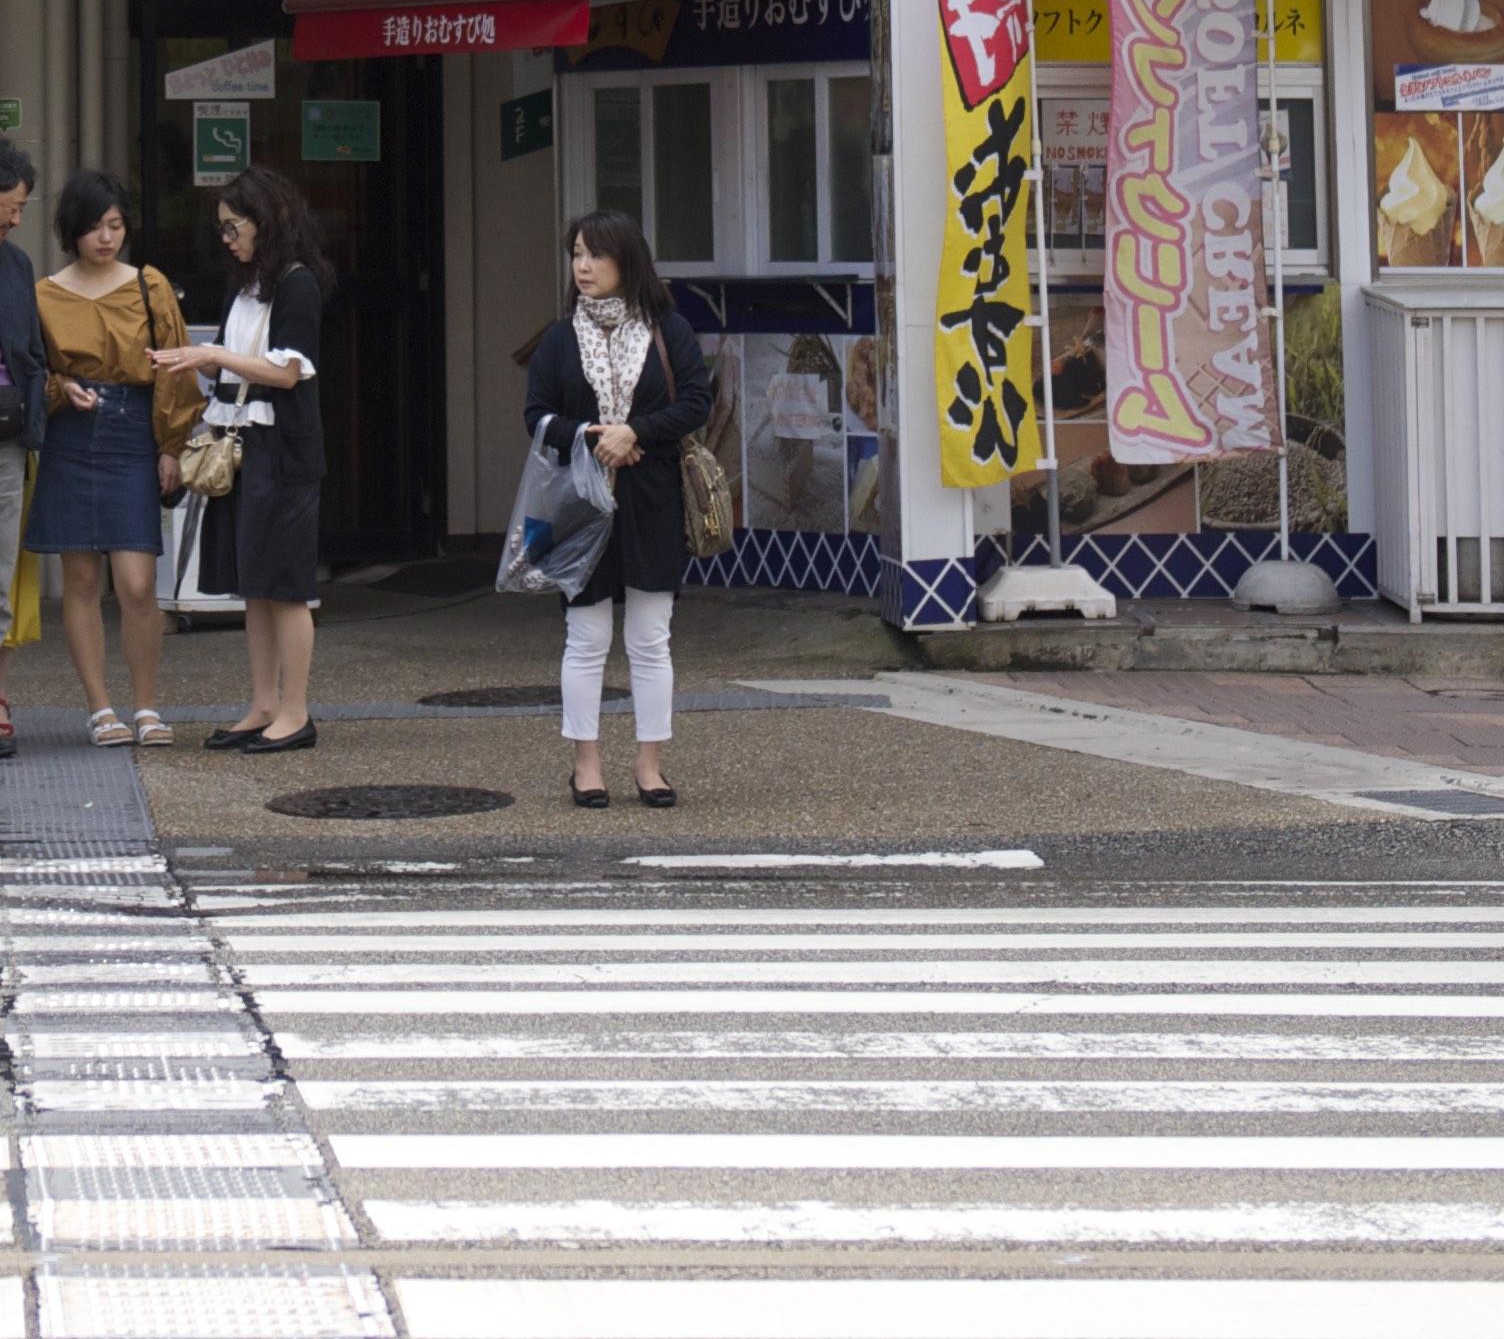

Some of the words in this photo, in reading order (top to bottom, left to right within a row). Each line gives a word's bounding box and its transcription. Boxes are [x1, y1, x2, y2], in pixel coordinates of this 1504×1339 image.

[382, 14, 496, 47] 手造りおむすび処
[514, 106, 527, 144] 2F
